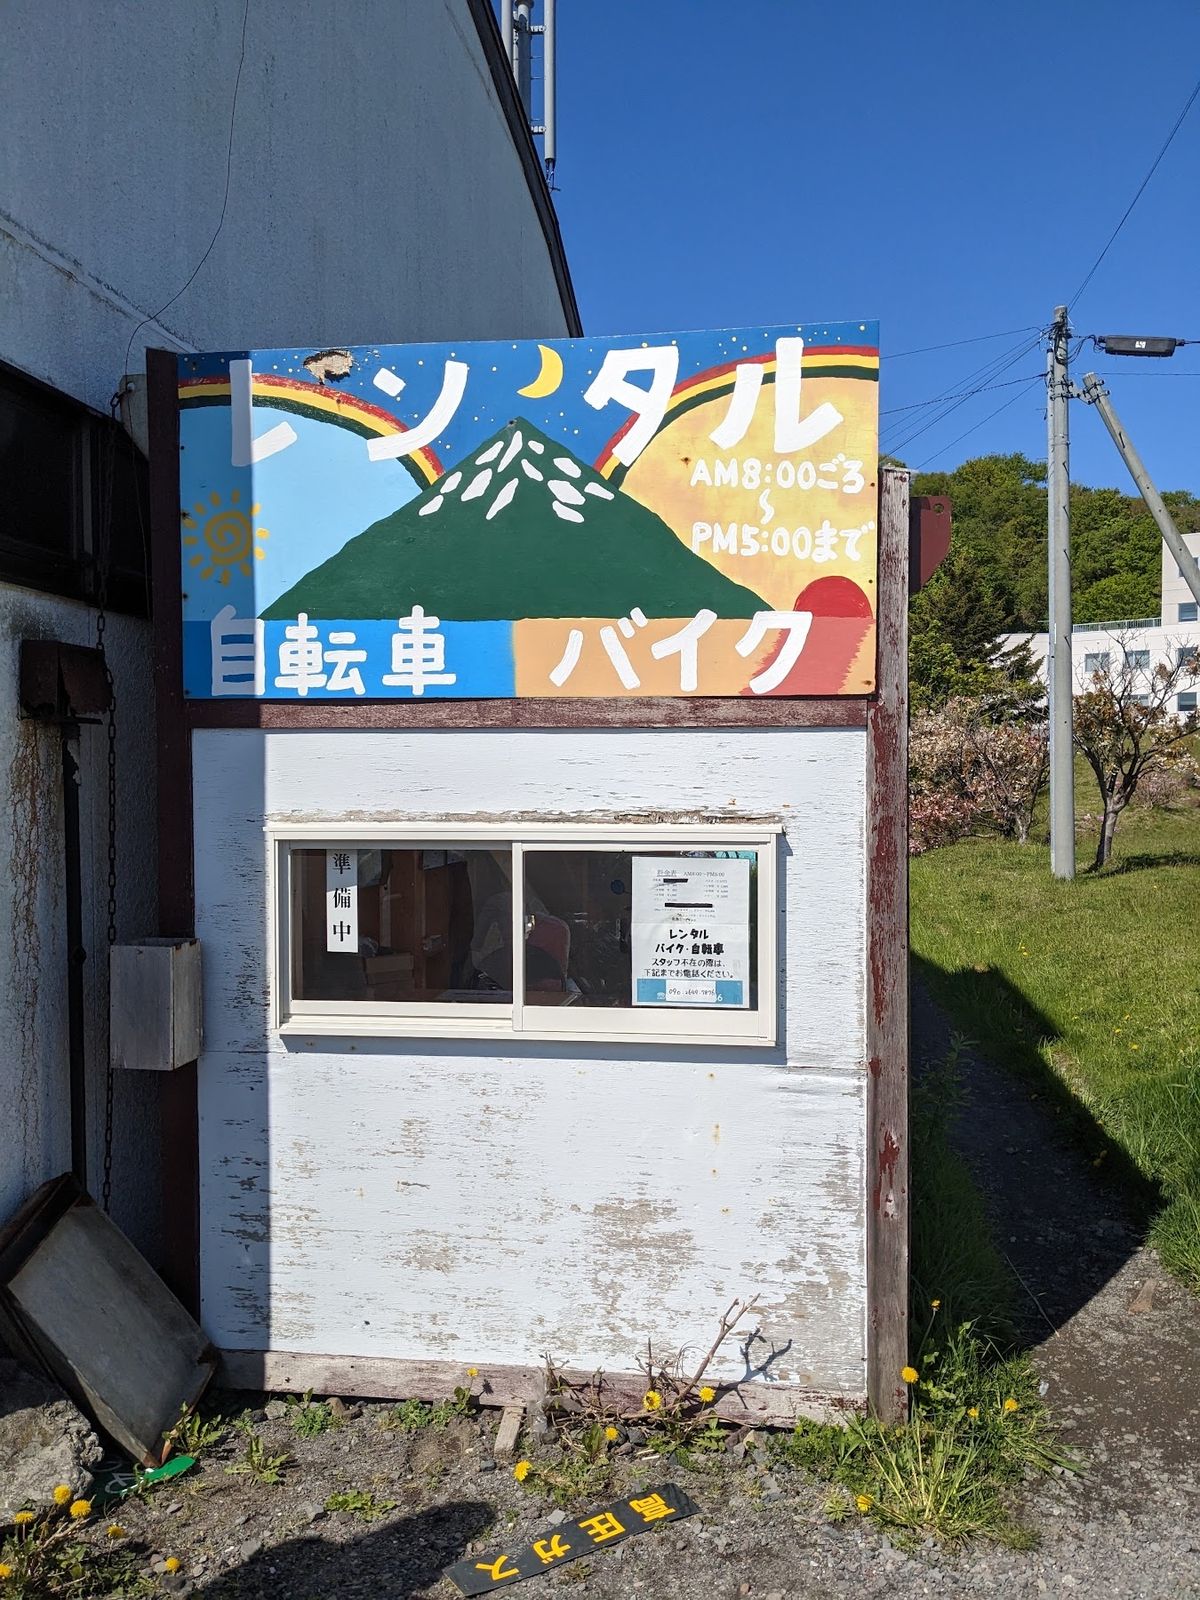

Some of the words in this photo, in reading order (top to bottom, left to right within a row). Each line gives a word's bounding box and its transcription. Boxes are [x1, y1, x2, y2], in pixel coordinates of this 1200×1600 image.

[229, 337, 844, 467] レンタル
[690, 453, 865, 494] AM8:00ごろ
[691, 520, 875, 563] PM5:00まで
[211, 605, 456, 696] 自転車
[548, 607, 813, 695] バイク
[333, 853, 351, 942] 準備中
[654, 942, 724, 955] バイク・自転車
[669, 928, 709, 939] レンタル
[644, 968, 733, 978] 下記までお電話ください。
[475, 1493, 676, 1581] 高圧ガス
